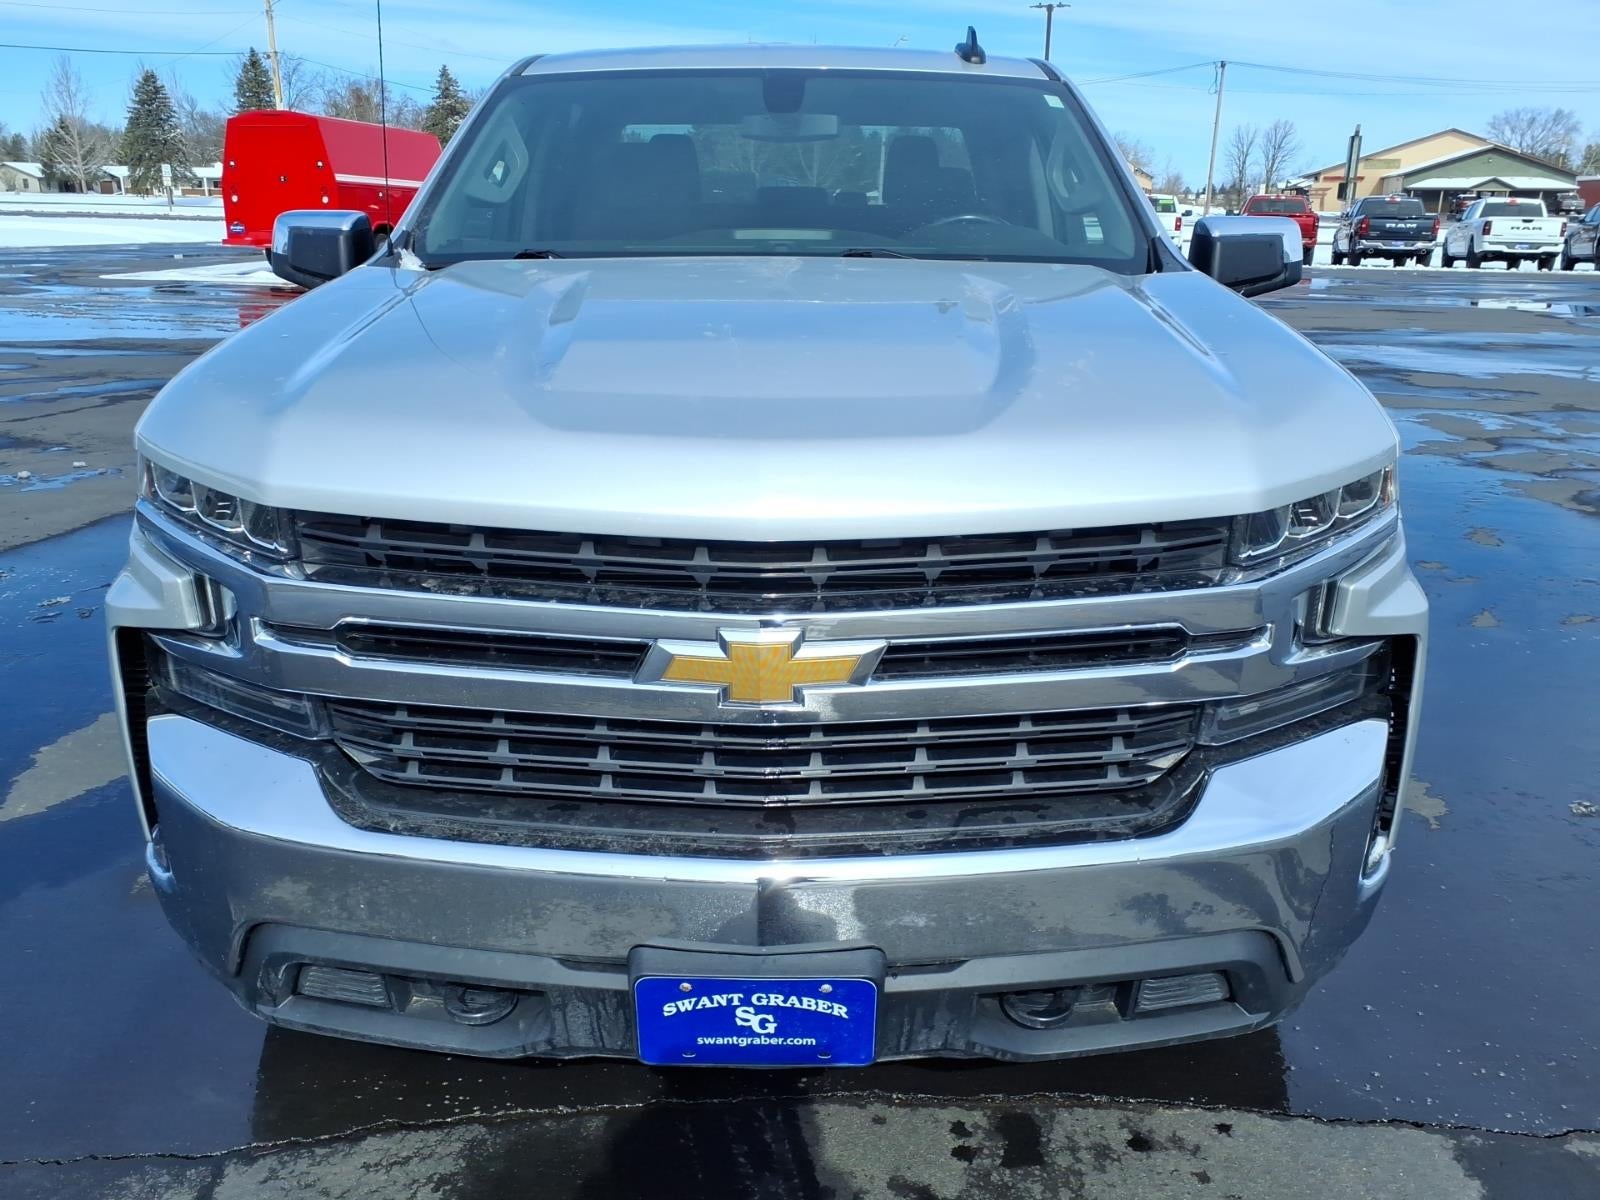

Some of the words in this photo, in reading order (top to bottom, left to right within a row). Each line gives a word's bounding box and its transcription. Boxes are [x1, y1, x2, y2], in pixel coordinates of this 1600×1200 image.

[662, 993, 744, 1017] SWANT
[751, 993, 849, 1019] GRABER
[735, 1006, 777, 1034] SG
[697, 1035, 816, 1047] swantgraber.com
